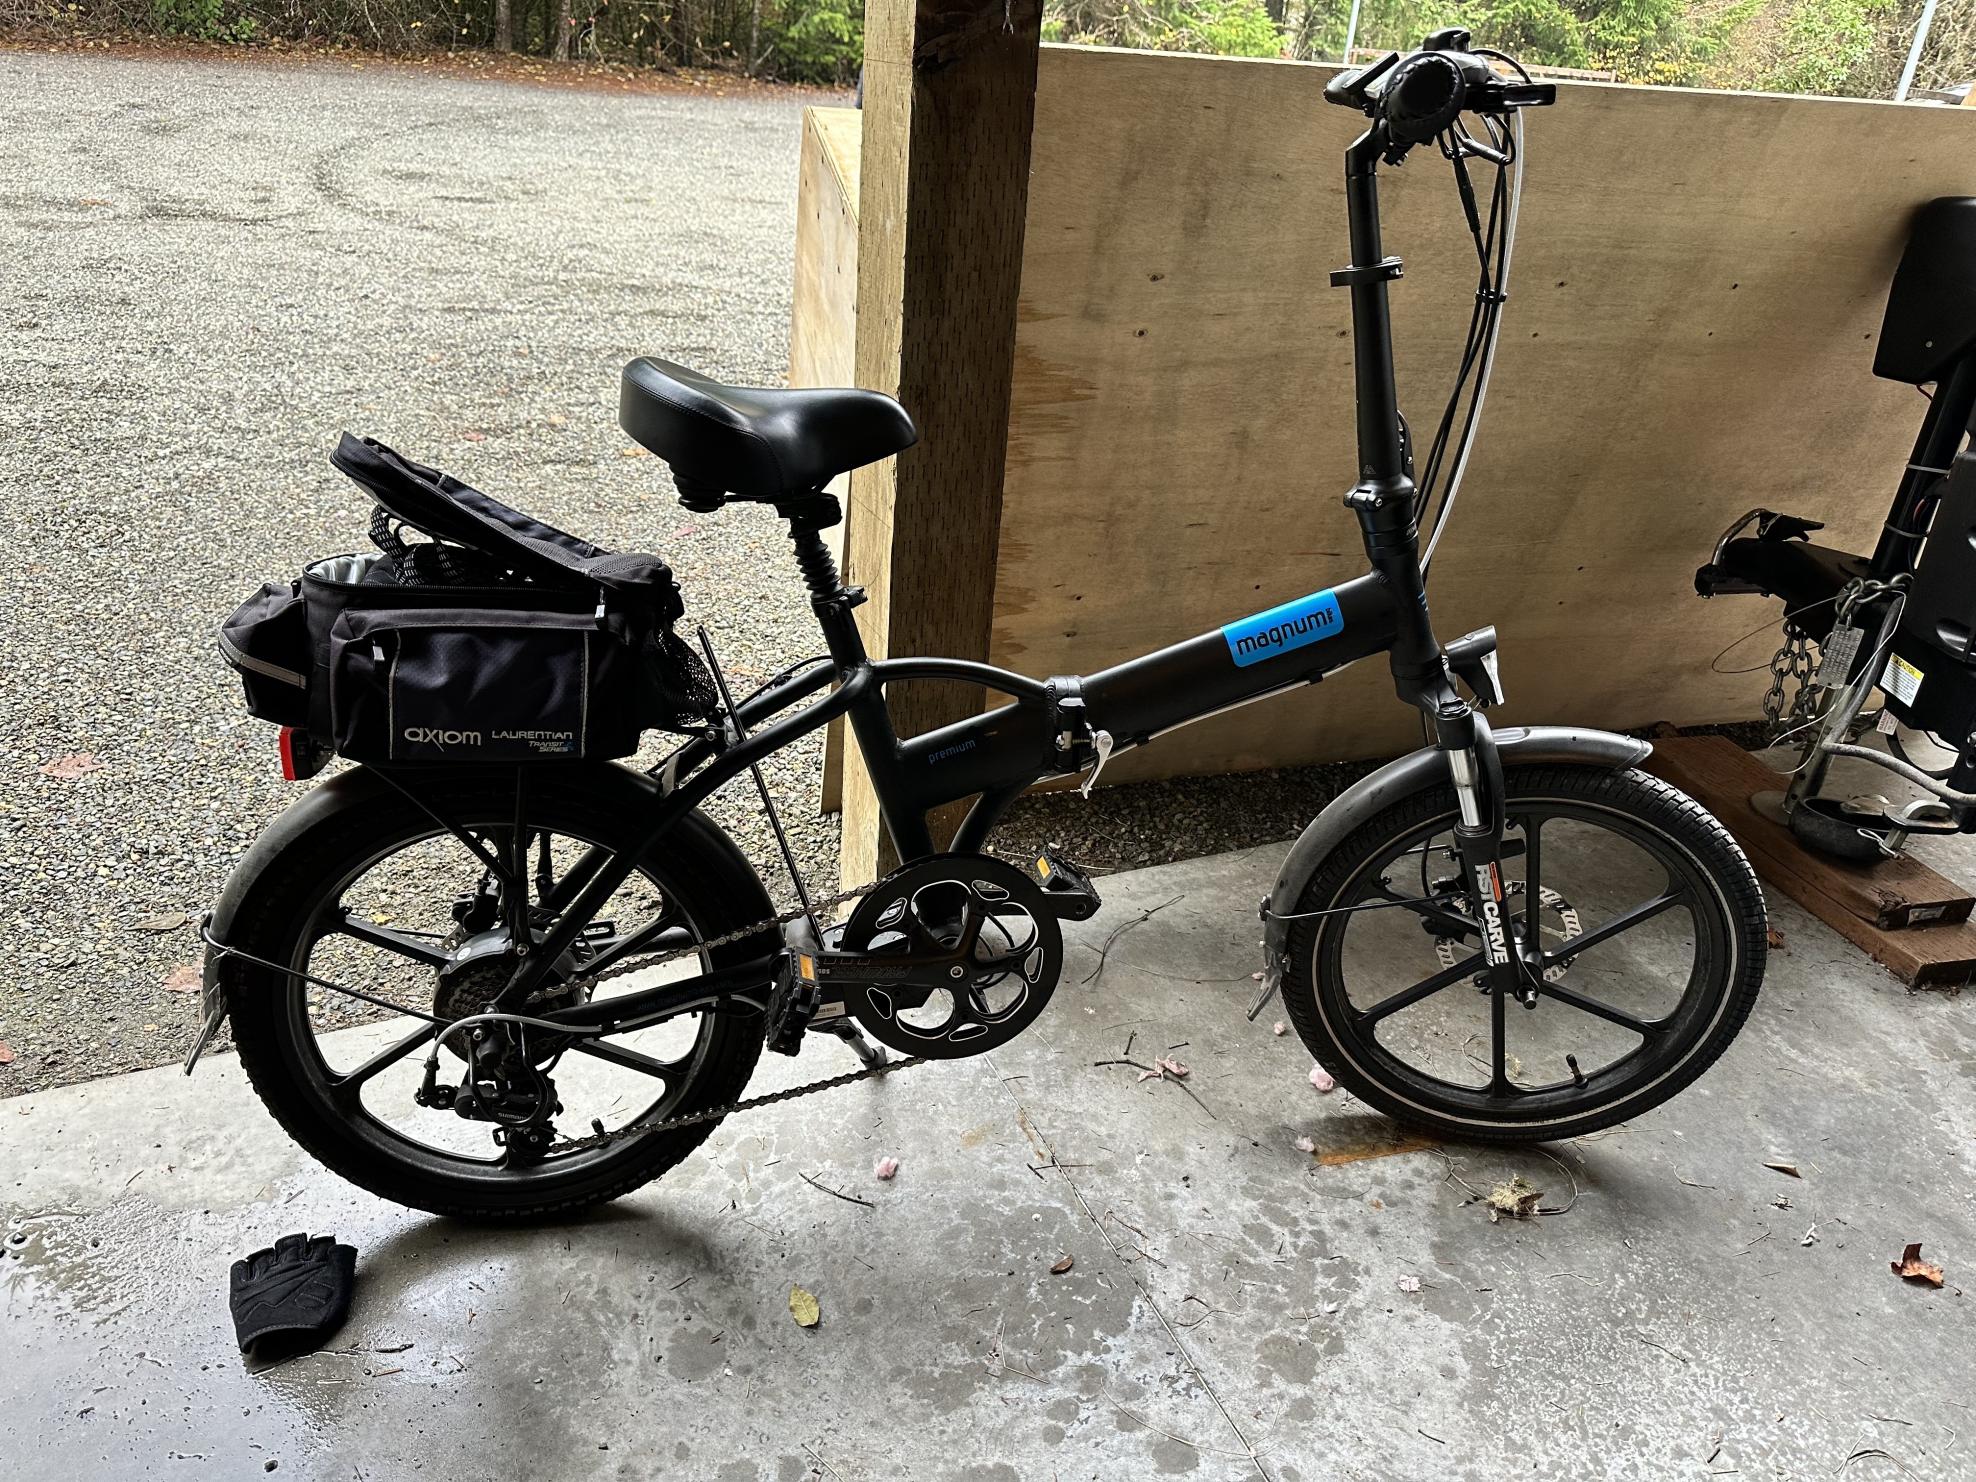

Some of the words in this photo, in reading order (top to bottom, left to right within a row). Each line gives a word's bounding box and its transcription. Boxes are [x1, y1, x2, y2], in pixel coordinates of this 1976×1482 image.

[1236, 611, 1327, 655] magnum
[404, 727, 481, 752] axiom
[491, 730, 573, 740] LAURENTIAN
[928, 739, 976, 765] premium
[1474, 864, 1497, 902] RST
[1483, 901, 1509, 964] CARVE
